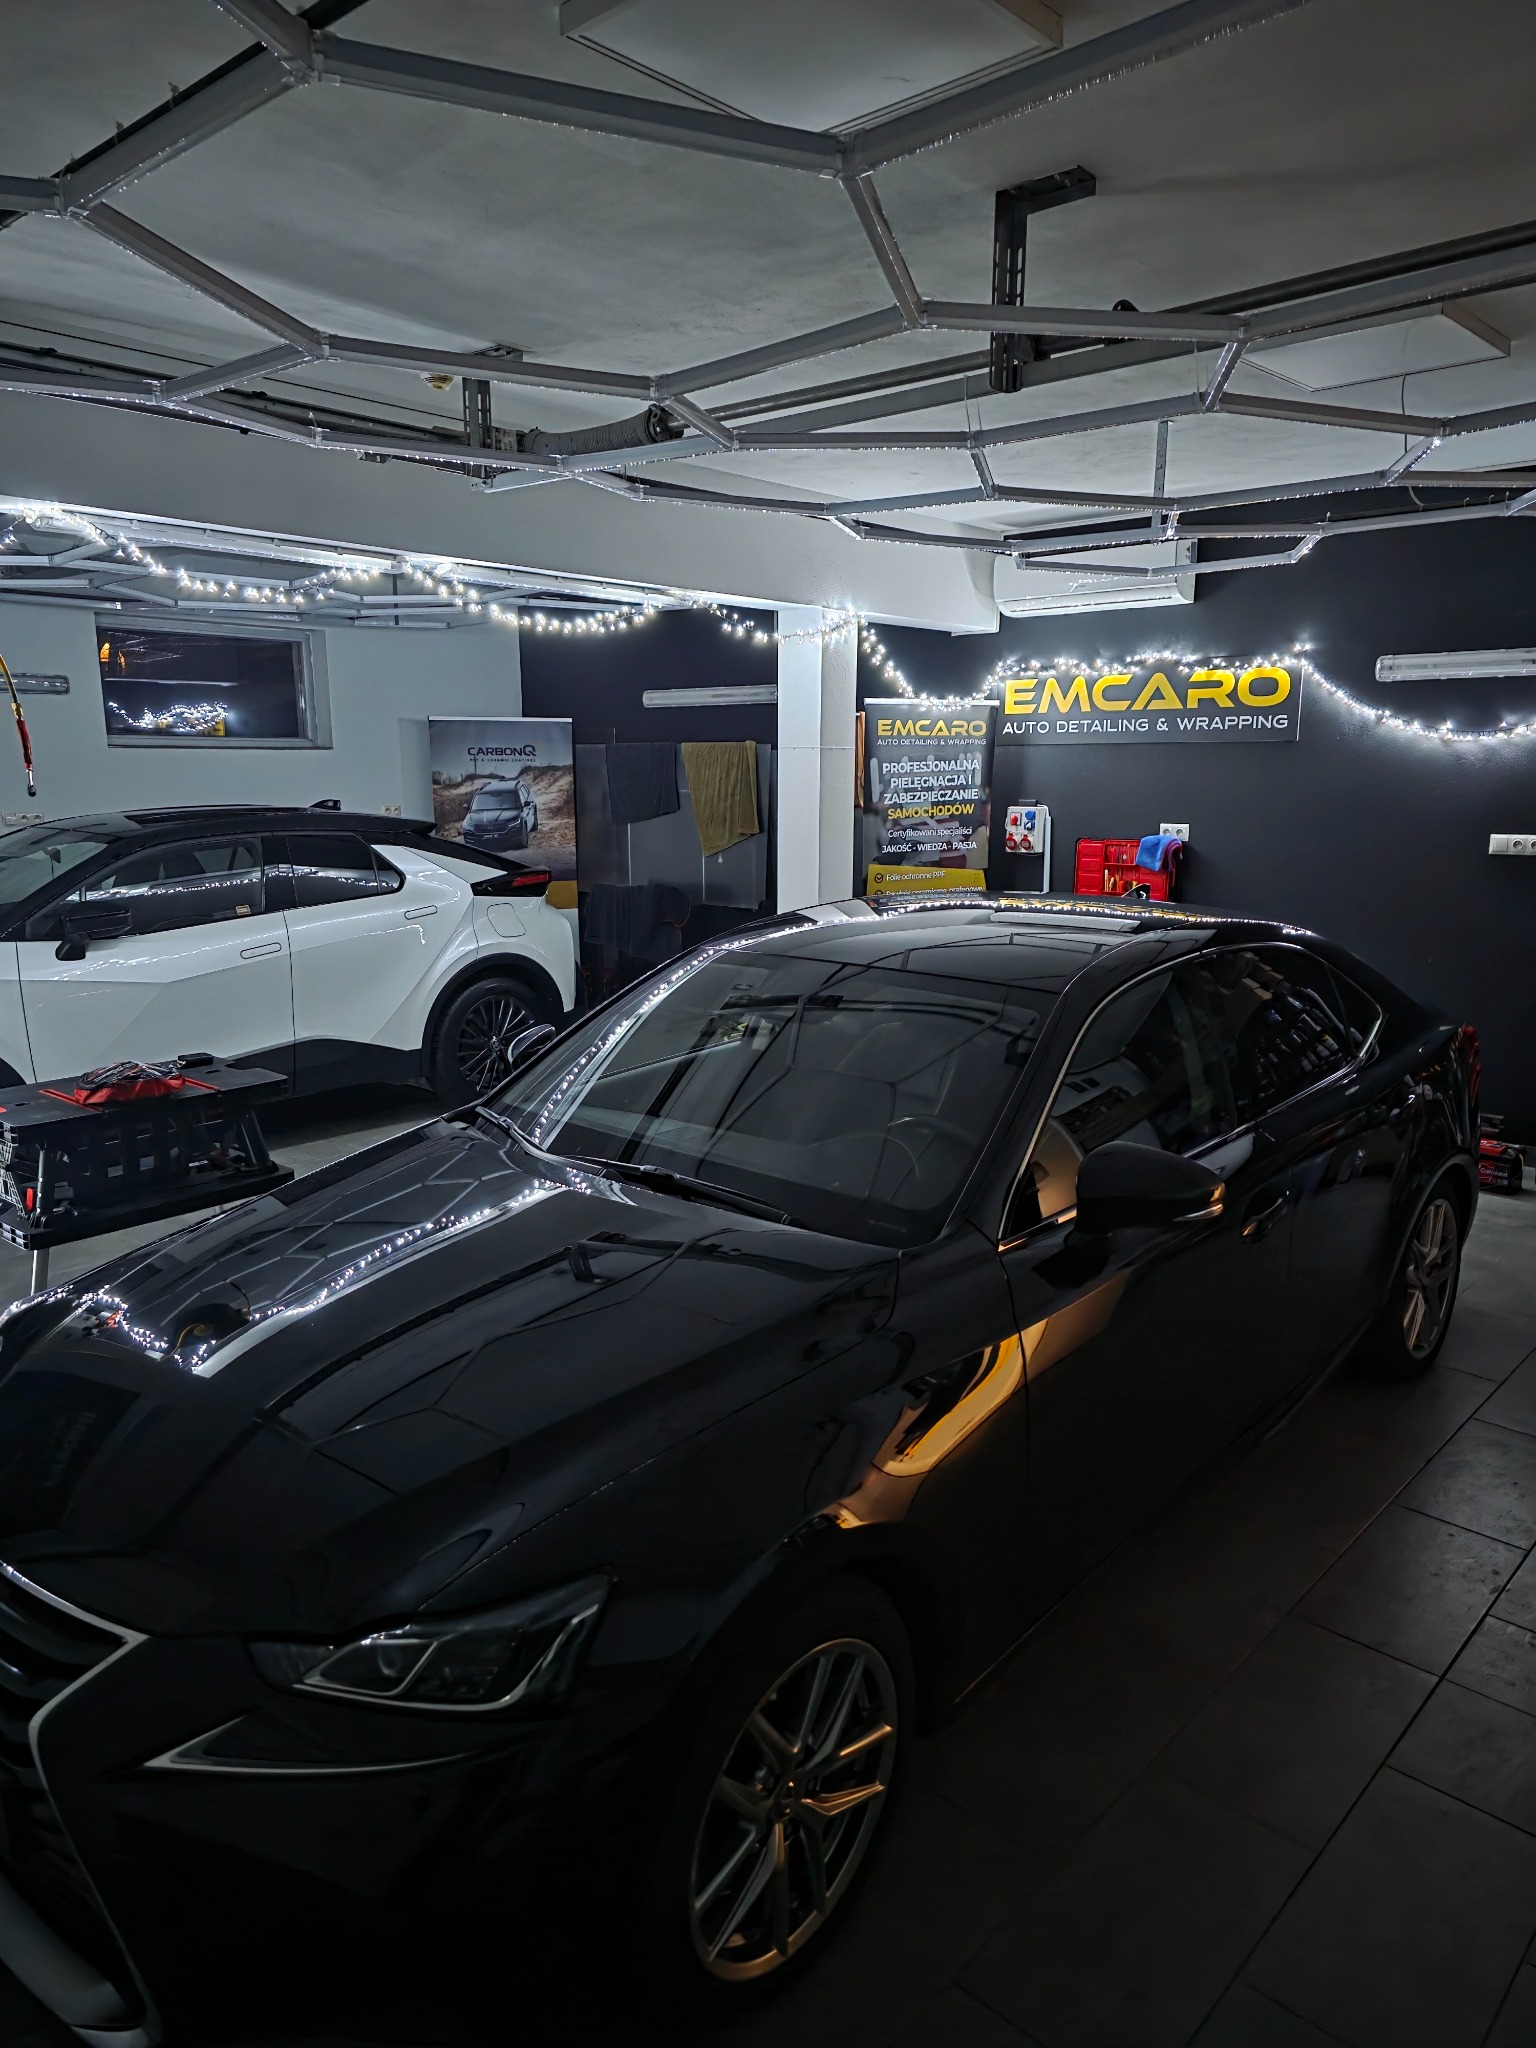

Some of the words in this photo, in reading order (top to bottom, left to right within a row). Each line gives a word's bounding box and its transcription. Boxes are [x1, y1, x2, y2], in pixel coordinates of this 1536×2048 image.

[1004, 666, 1291, 715] EMCARO
[877, 719, 987, 737] EMCARO
[1002, 721, 1050, 735] AUTO
[1056, 718, 1149, 733] DETAILING
[1156, 717, 1169, 731] &
[1177, 714, 1289, 731] WRAPPING
[877, 738, 899, 746] AUTO
[900, 738, 939, 746] DETAILING
[947, 738, 987, 746] WRAPPING
[467, 744, 537, 757] CARBONQ
[882, 759, 980, 775] PROFESJONALNA
[890, 774, 966, 791] PIELĘGNACJA
[883, 788, 979, 805] ZABEZPIECZANIE
[887, 802, 975, 819] SAMOCHODÓW
[887, 828, 937, 839] Certyfikowani
[937, 826, 973, 837] specjaliści
[881, 843, 912, 853] JAKOŚĆ
[917, 842, 948, 851] WIEDZA
[952, 841, 978, 850] PASJA
[886, 873, 901, 881] Folie
[901, 872, 932, 880] ochronne
[932, 870, 946, 878] PPF
